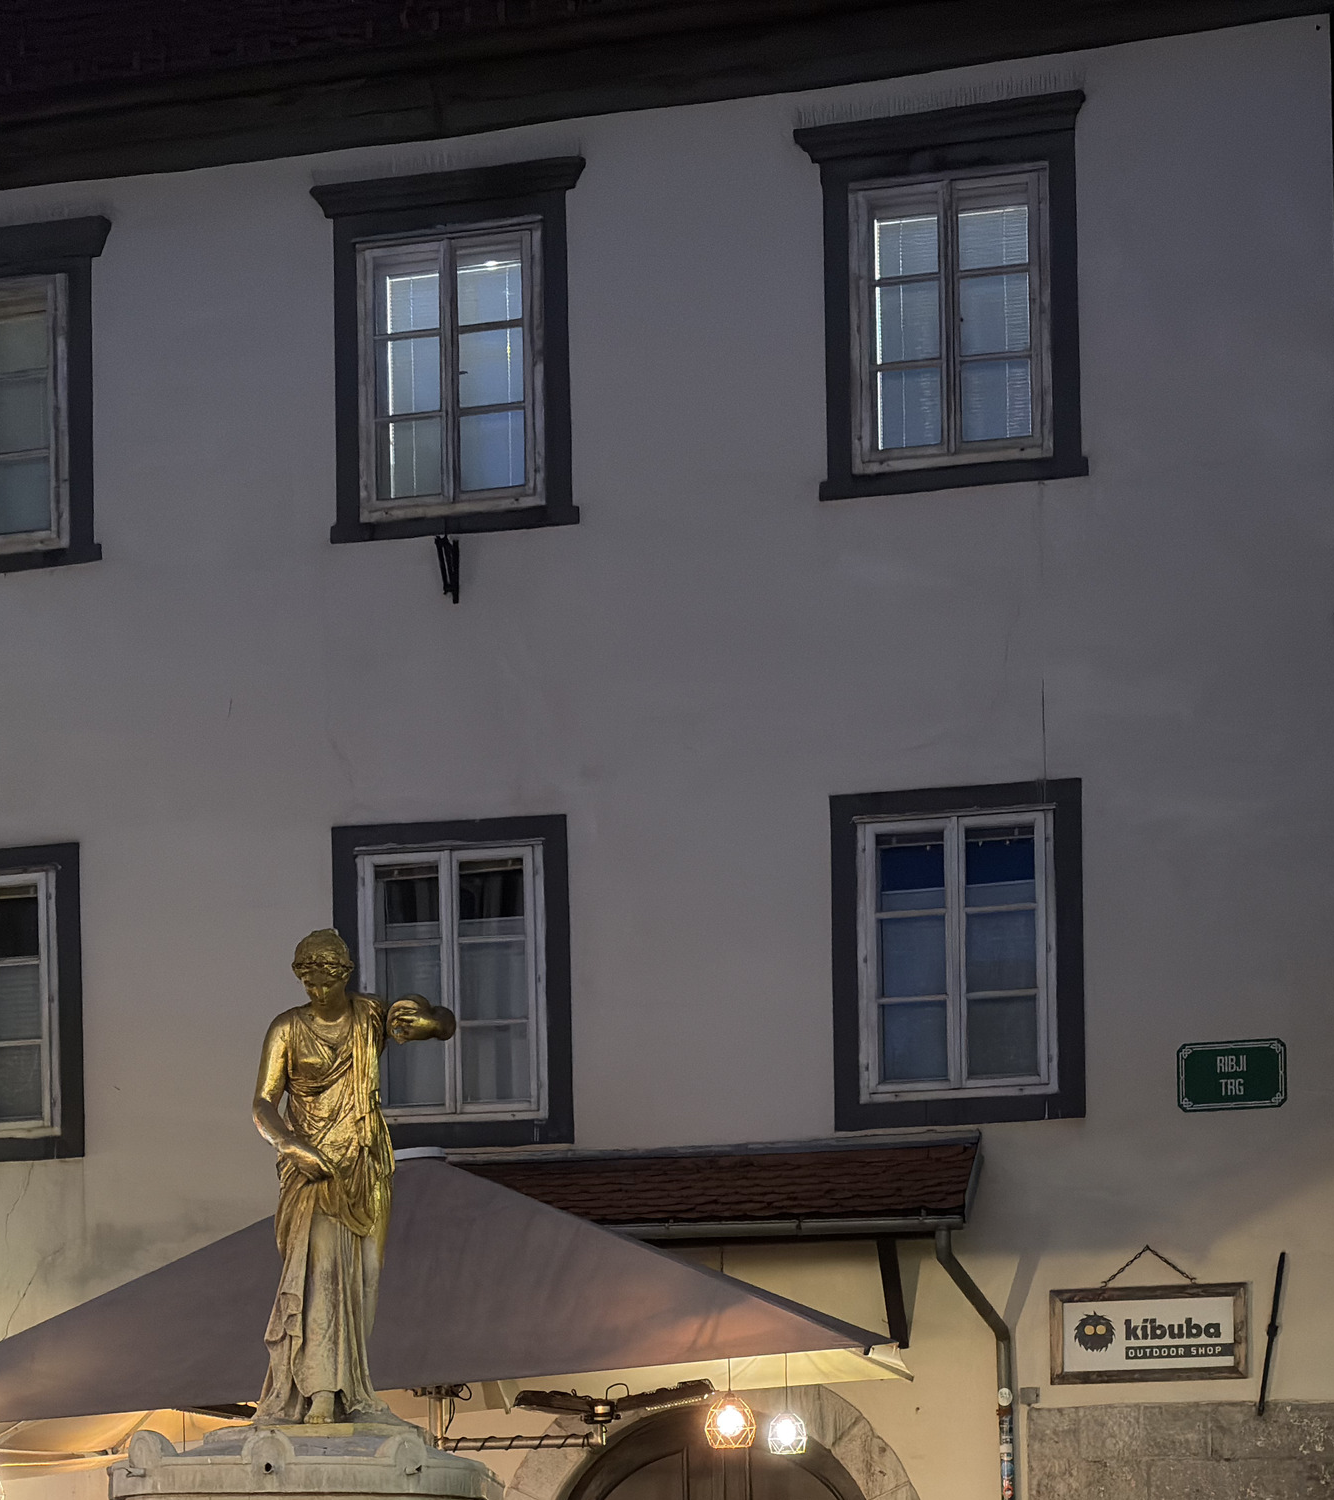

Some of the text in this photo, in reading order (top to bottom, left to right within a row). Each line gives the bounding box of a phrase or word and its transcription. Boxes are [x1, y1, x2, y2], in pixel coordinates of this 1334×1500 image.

[1216, 1055, 1247, 1074] RIBJI
[1219, 1078, 1244, 1096] TRG
[1124, 1317, 1221, 1340] kibuba
[1128, 1346, 1222, 1357] OUTDOOR SHOP
